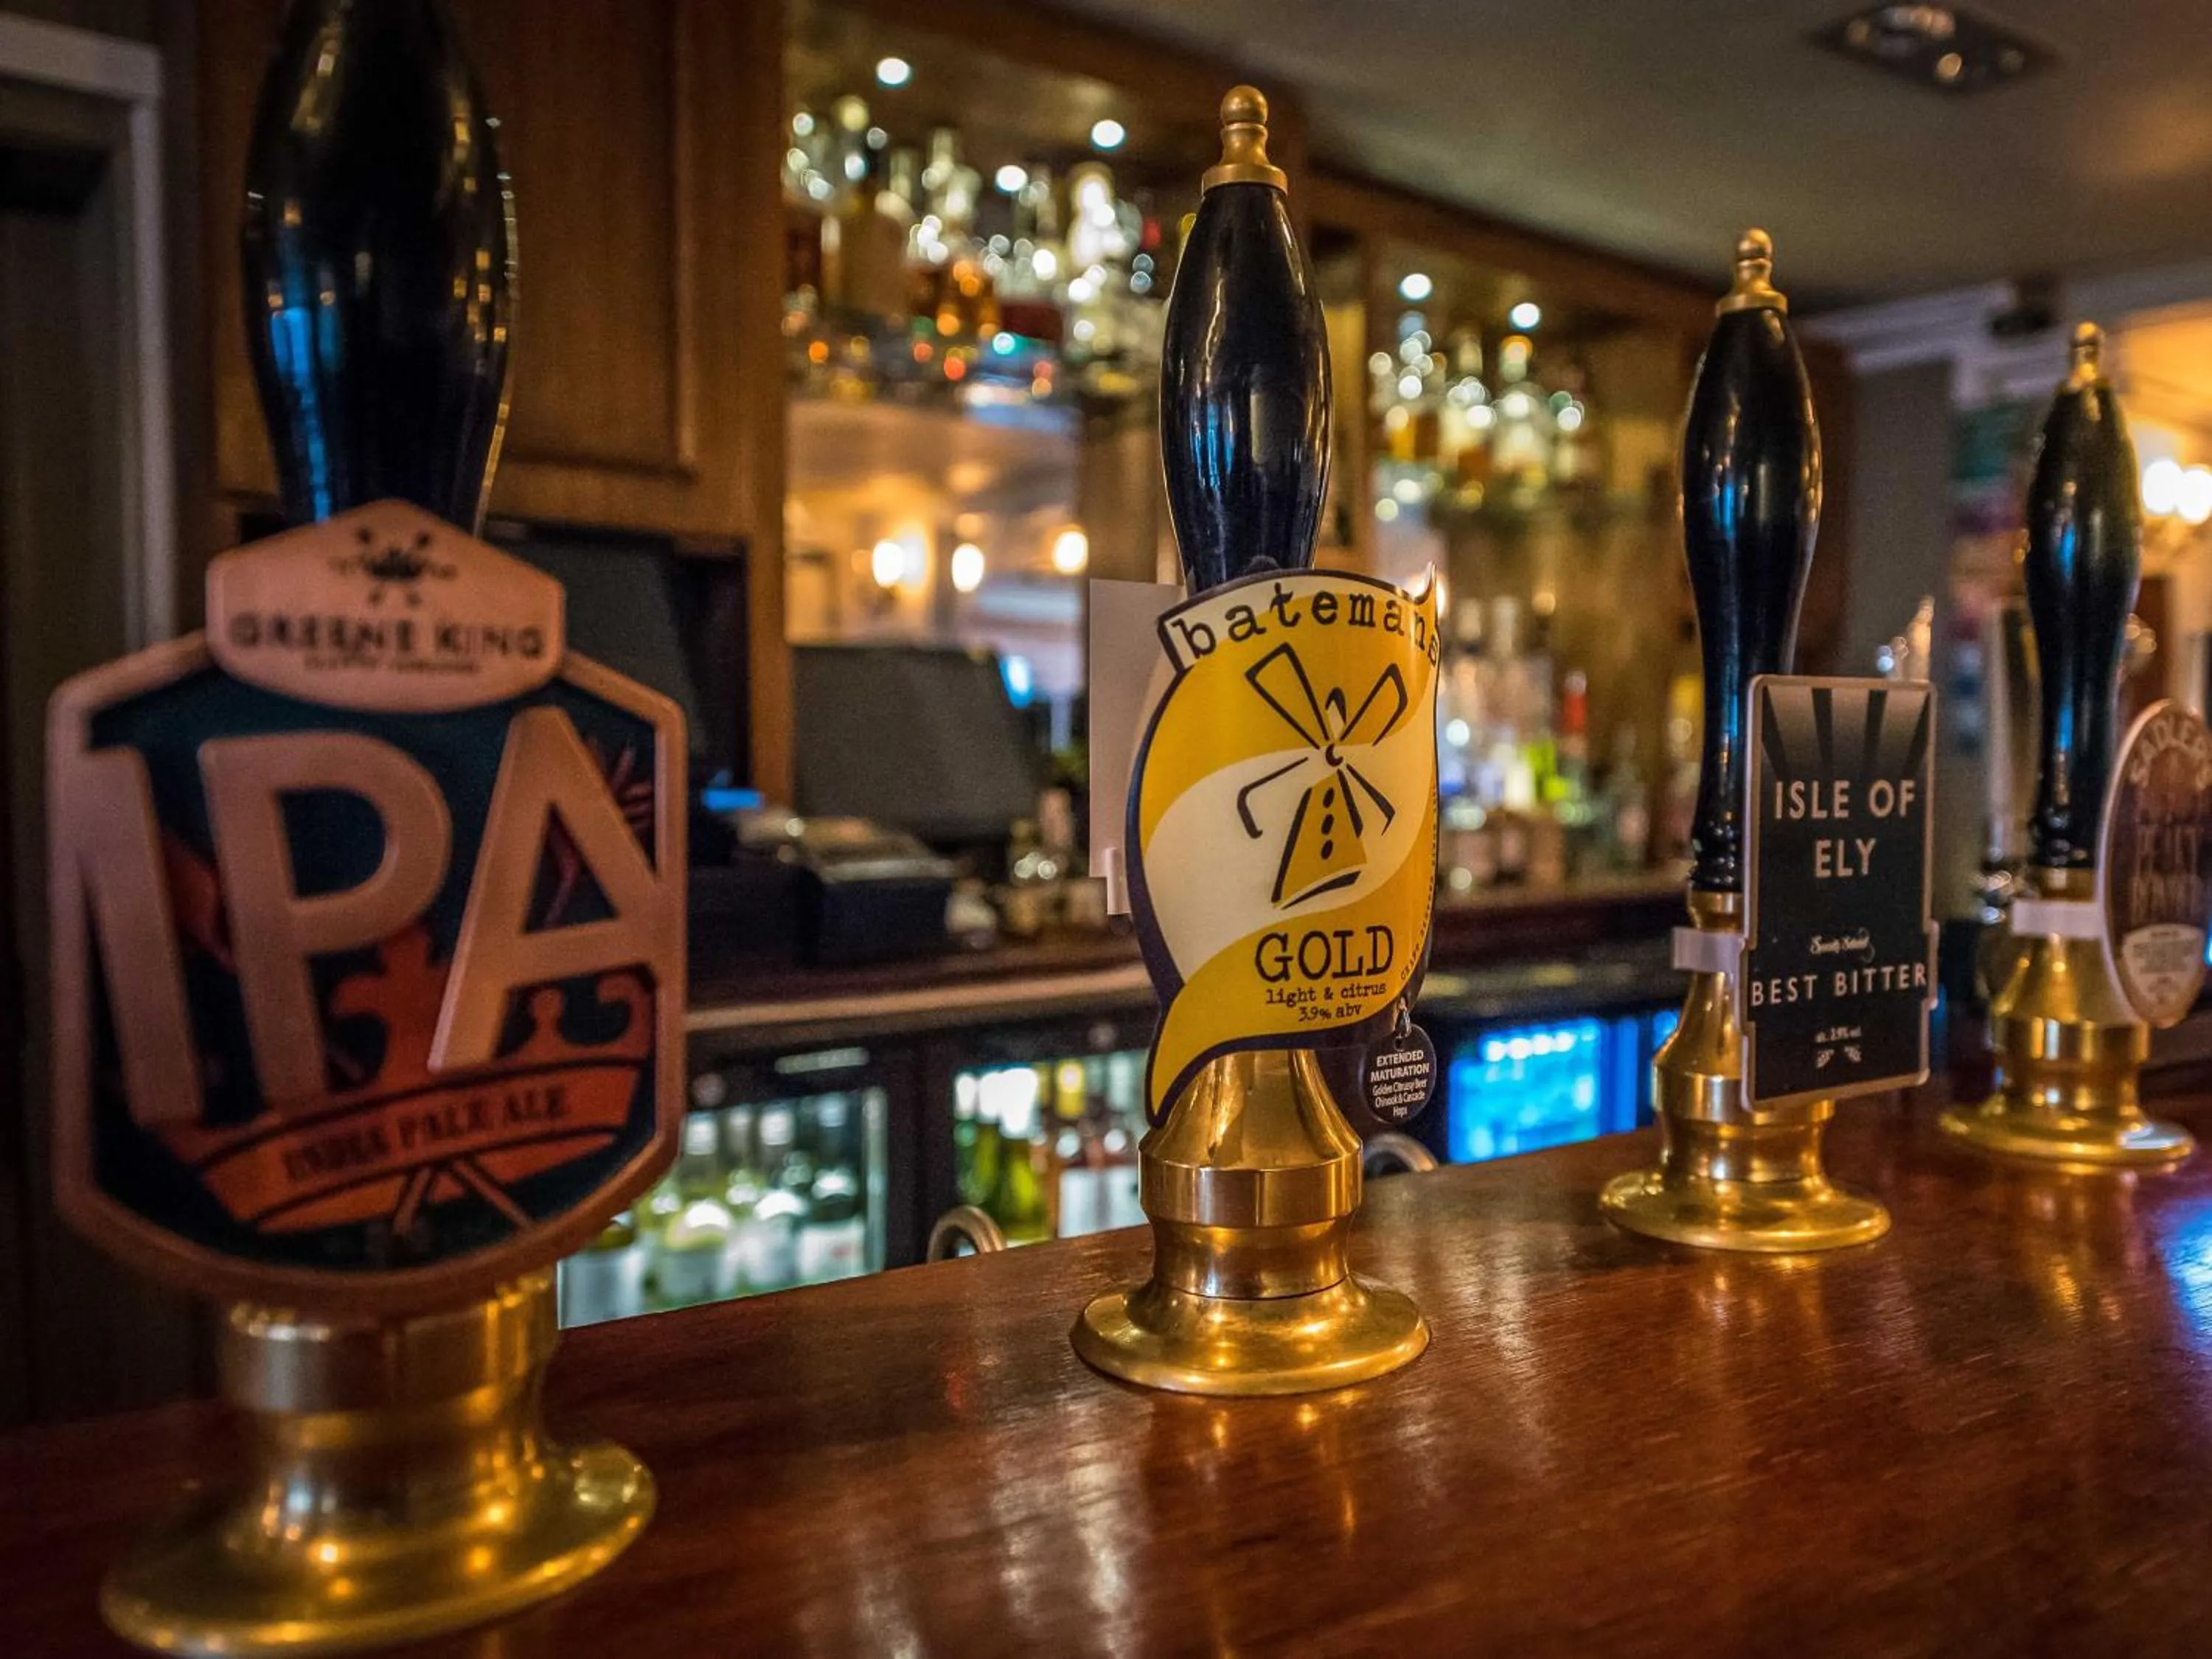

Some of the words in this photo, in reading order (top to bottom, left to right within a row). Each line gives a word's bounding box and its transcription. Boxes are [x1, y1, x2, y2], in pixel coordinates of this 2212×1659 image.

[228, 611, 414, 652] GREENE
[435, 618, 544, 658] KING
[1171, 582, 1439, 666] batemans
[1775, 779, 1850, 819] ISLE
[1868, 779, 1916, 818] OF
[1815, 837, 1877, 877] ELY
[55, 704, 683, 1126] IPA
[1254, 925, 1394, 983] GOLD
[1265, 987, 1317, 1008] light
[1324, 986, 1334, 1001] &
[1340, 983, 1387, 998] citrus
[1750, 974, 1818, 1006] BEST
[1834, 961, 1927, 997] BITTER
[1335, 1003, 1363, 1018] abv
[1370, 1062, 1430, 1082] MATURATION
[1376, 1049, 1424, 1068] EXTENDED
